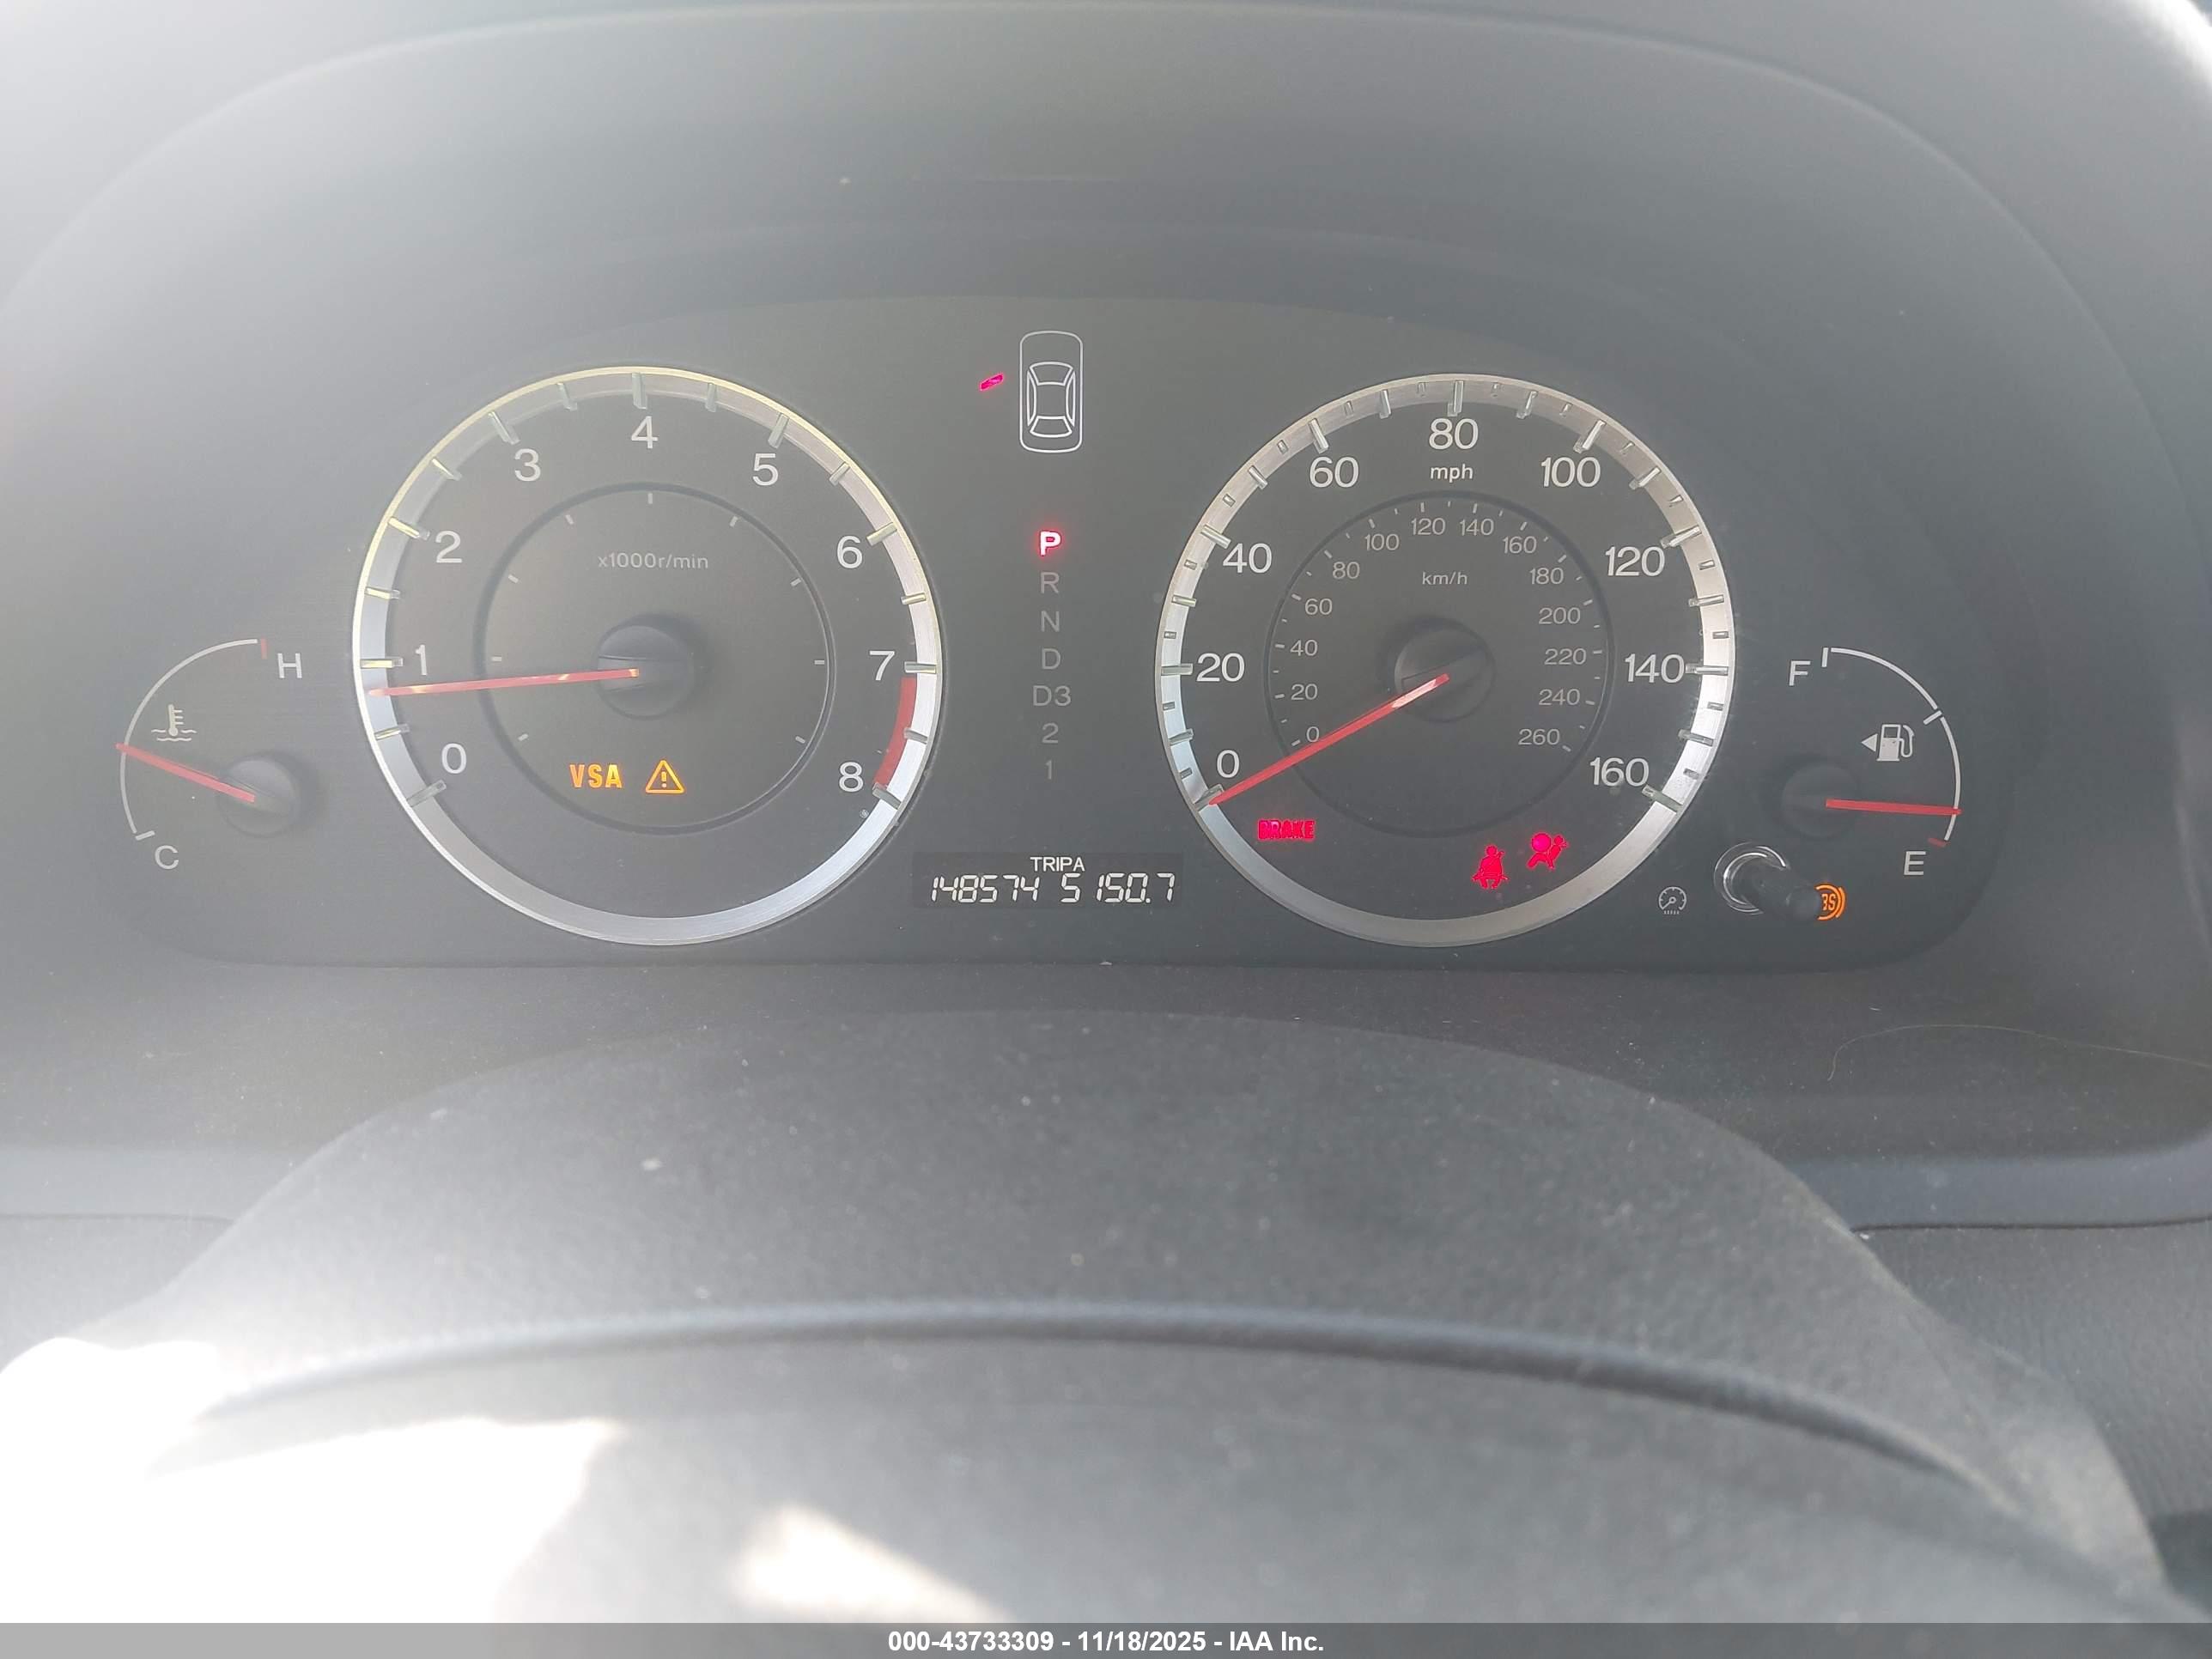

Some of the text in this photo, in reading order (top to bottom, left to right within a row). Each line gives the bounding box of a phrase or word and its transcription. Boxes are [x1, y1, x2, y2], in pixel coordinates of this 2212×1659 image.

[632, 416, 658, 448] 4
[1429, 419, 1479, 449] 80
[515, 443, 540, 481] 3
[753, 453, 778, 485] 5
[1310, 457, 1359, 488] 60
[1431, 464, 1473, 483] mph
[1540, 459, 1601, 488] 100
[1411, 518, 1446, 536] 120
[1460, 518, 1494, 536] 140
[436, 531, 462, 562] 2
[837, 536, 864, 568] 6
[1041, 532, 1060, 555] P
[1365, 534, 1399, 550] 100
[1504, 537, 1536, 553] 160
[1223, 544, 1273, 574] 40
[1606, 547, 1665, 576] 120
[1042, 572, 1059, 593] R
[1333, 562, 1360, 580] 80
[1423, 572, 1467, 584] km/h
[1530, 567, 1564, 586] 180
[1304, 598, 1333, 616] 60
[1539, 607, 1581, 624] 200
[1042, 611, 1059, 631] N
[1042, 648, 1060, 669] D
[1291, 640, 1317, 655] 40
[1545, 648, 1586, 665] 220
[278, 653, 301, 678] H
[416, 645, 427, 675] 1
[870, 651, 894, 680] 7
[1197, 653, 1245, 683] 20
[1626, 654, 1686, 684] 140
[1790, 661, 1810, 685] F
[1034, 685, 1071, 706] D3
[1291, 684, 1317, 700] 20
[1539, 689, 1580, 705] 240
[1042, 723, 1058, 743] 2
[1307, 726, 1319, 742] 0
[1519, 728, 1560, 748] 260
[442, 744, 466, 774] 0
[1218, 750, 1239, 777] 0
[570, 764, 622, 787] VSA
[840, 763, 863, 792] 8
[1590, 757, 1650, 787] 160
[1258, 819, 1315, 840] BRAKE
[155, 846, 179, 869] C
[1030, 857, 1085, 872] TRIPA
[1905, 851, 1925, 875] E
[932, 874, 1040, 902] 148574
